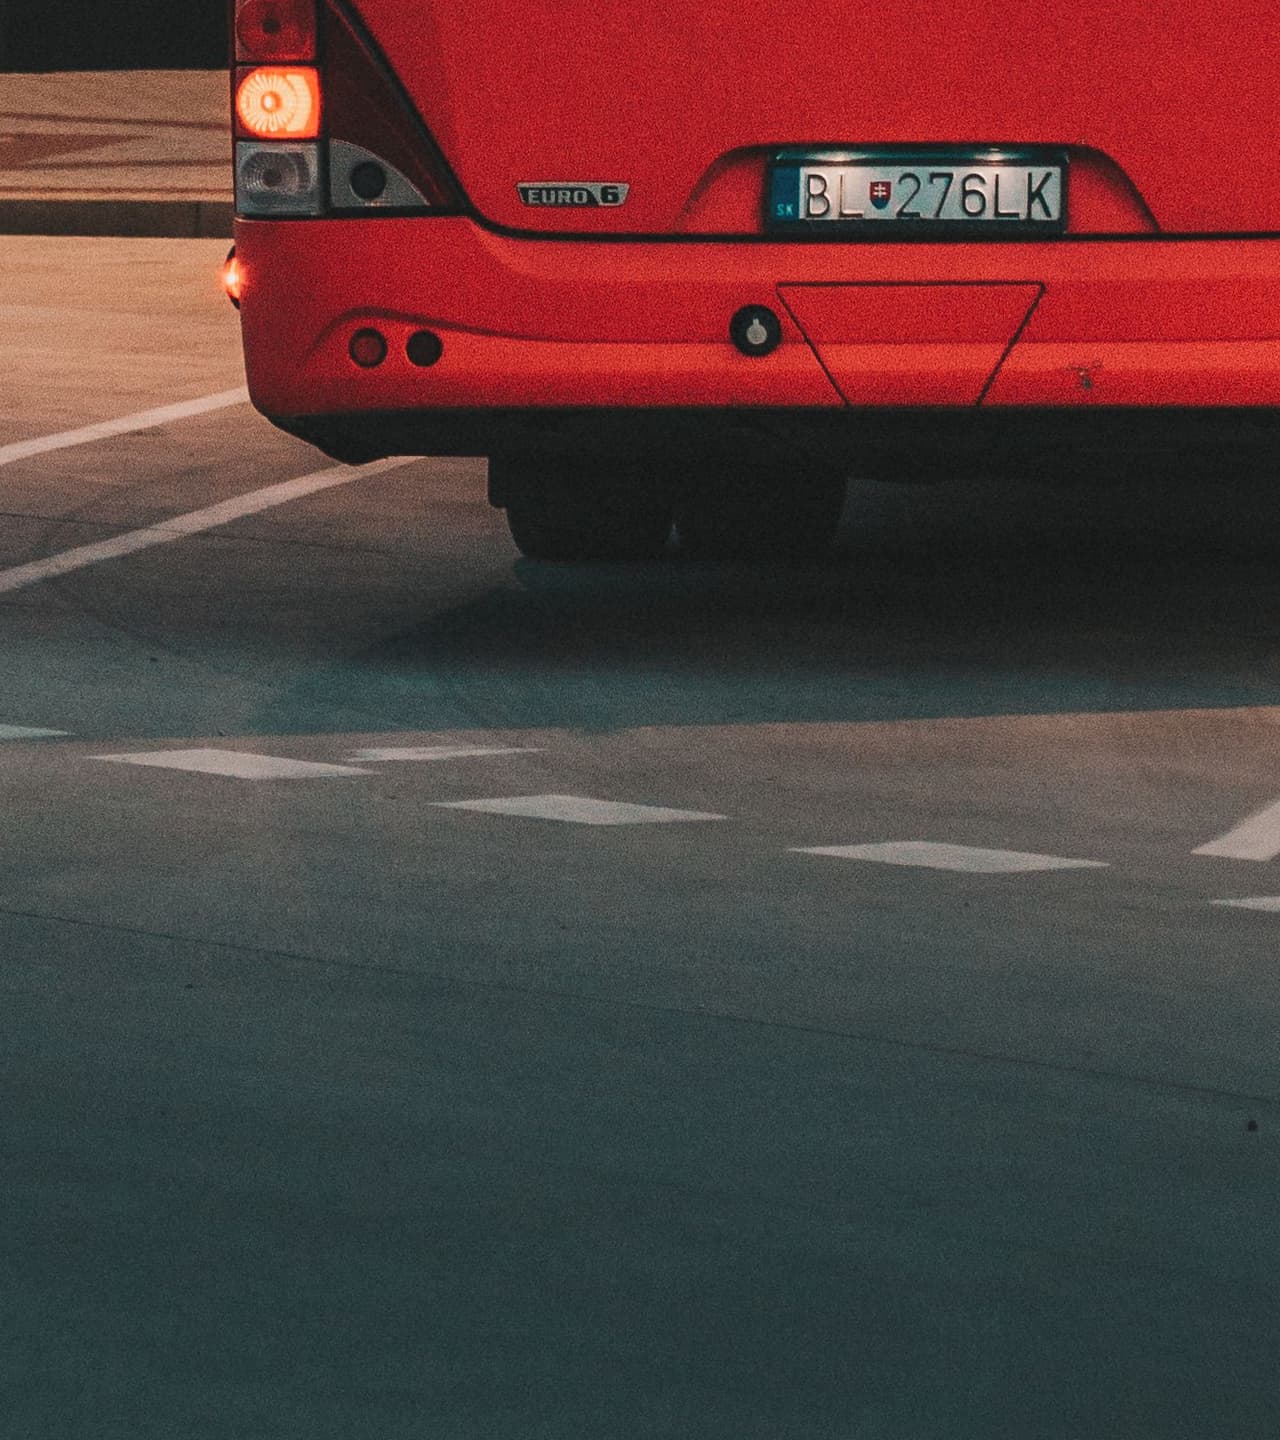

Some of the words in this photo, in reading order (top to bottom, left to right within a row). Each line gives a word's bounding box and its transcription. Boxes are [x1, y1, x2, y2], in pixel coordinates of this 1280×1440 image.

[527, 189, 588, 204] EURO
[601, 185, 620, 204] 6
[806, 173, 864, 218] BL
[896, 172, 1052, 218] 276LK
[775, 204, 794, 217] SK
